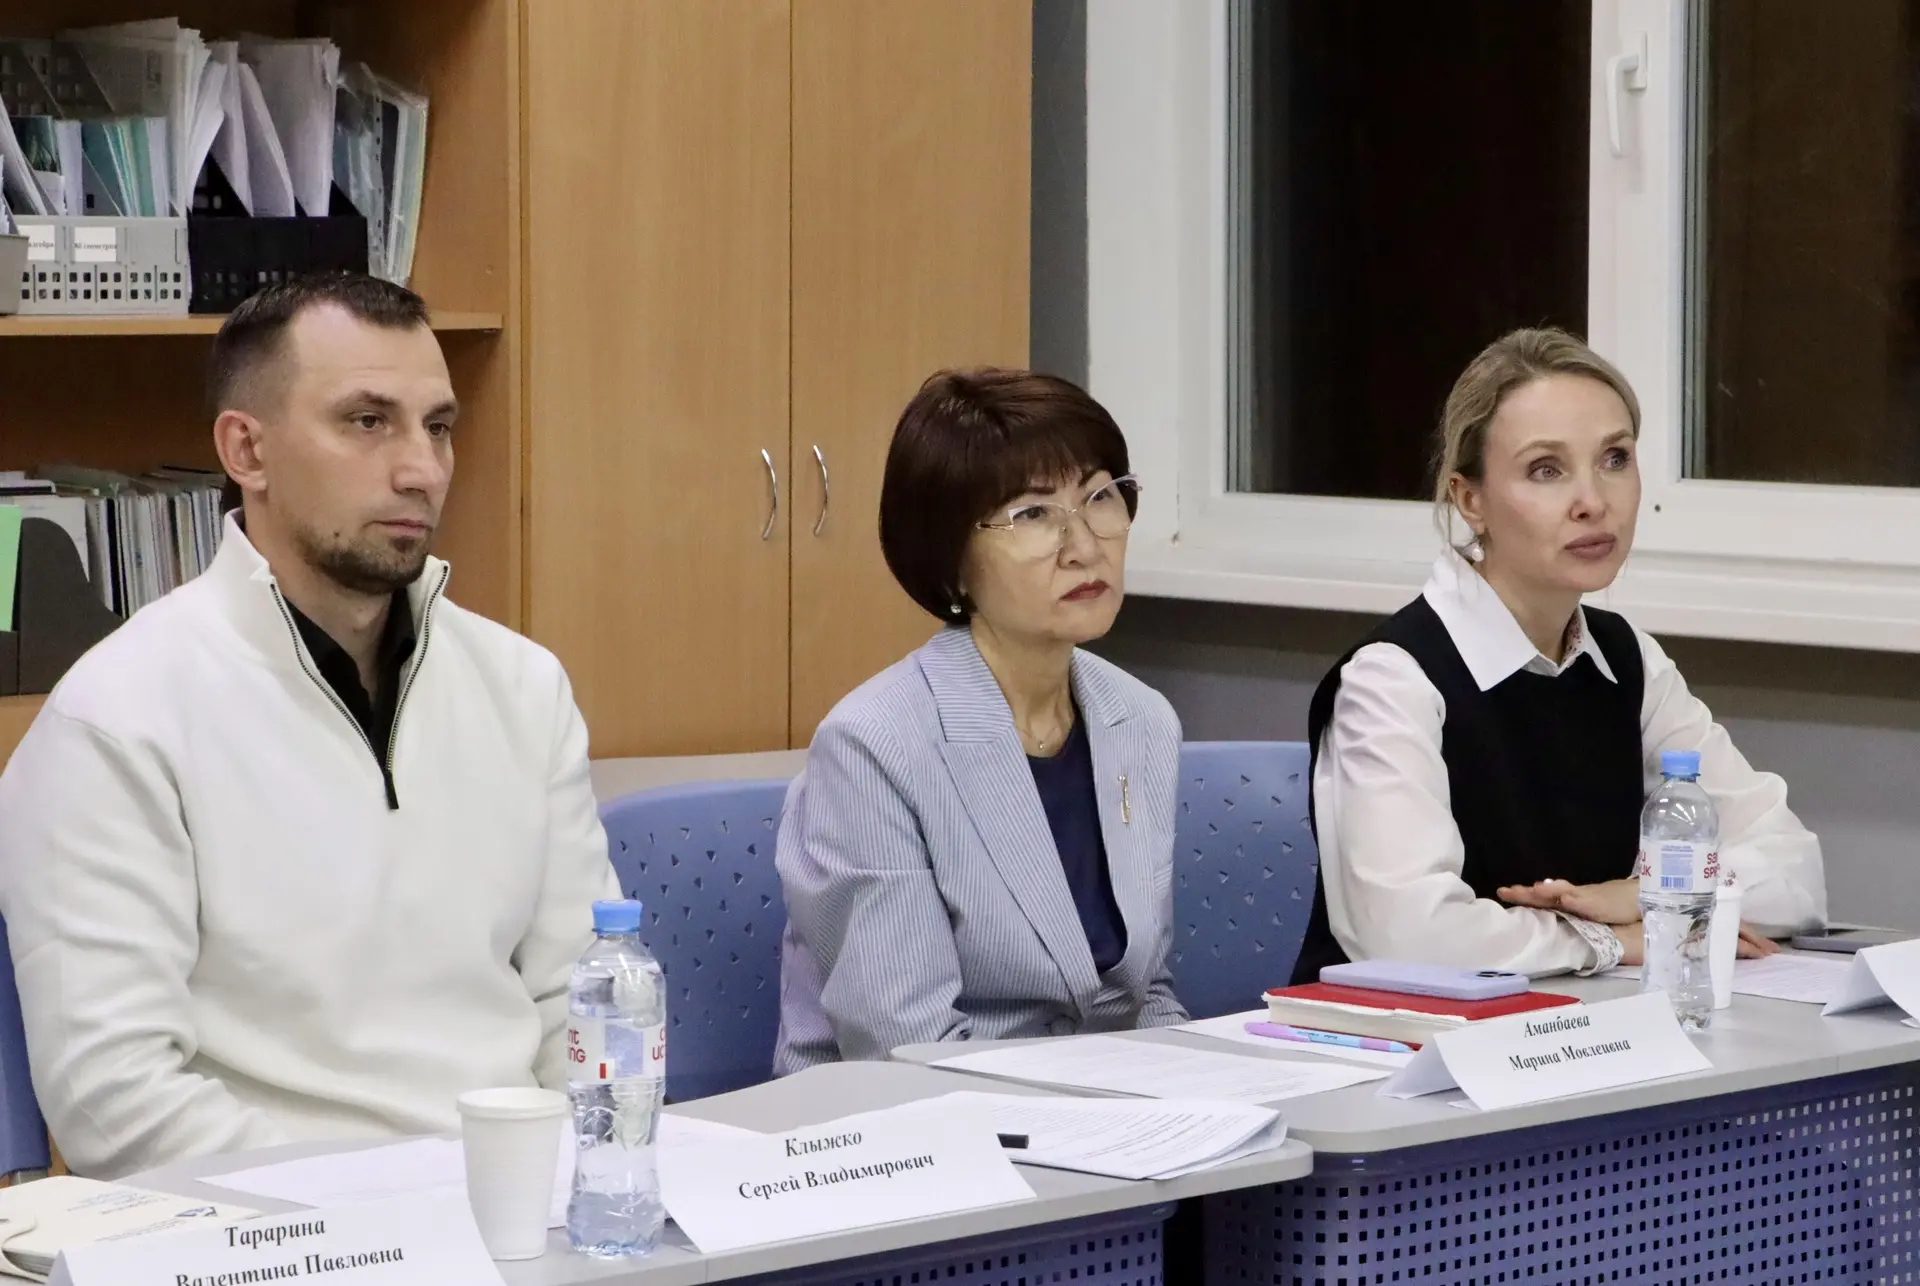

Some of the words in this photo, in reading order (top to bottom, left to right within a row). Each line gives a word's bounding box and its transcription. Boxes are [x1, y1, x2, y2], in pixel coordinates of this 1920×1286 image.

[1523, 1015, 1591, 1038] Аманбаева
[1508, 1052, 1561, 1071] Марина
[784, 1131, 863, 1158] Клыжко
[738, 1175, 801, 1201] Сергей
[804, 1154, 936, 1188] Владимирович
[224, 1219, 327, 1249] Тарарина
[175, 1263, 299, 1286] Валентина
[304, 1247, 405, 1276] Павловна
